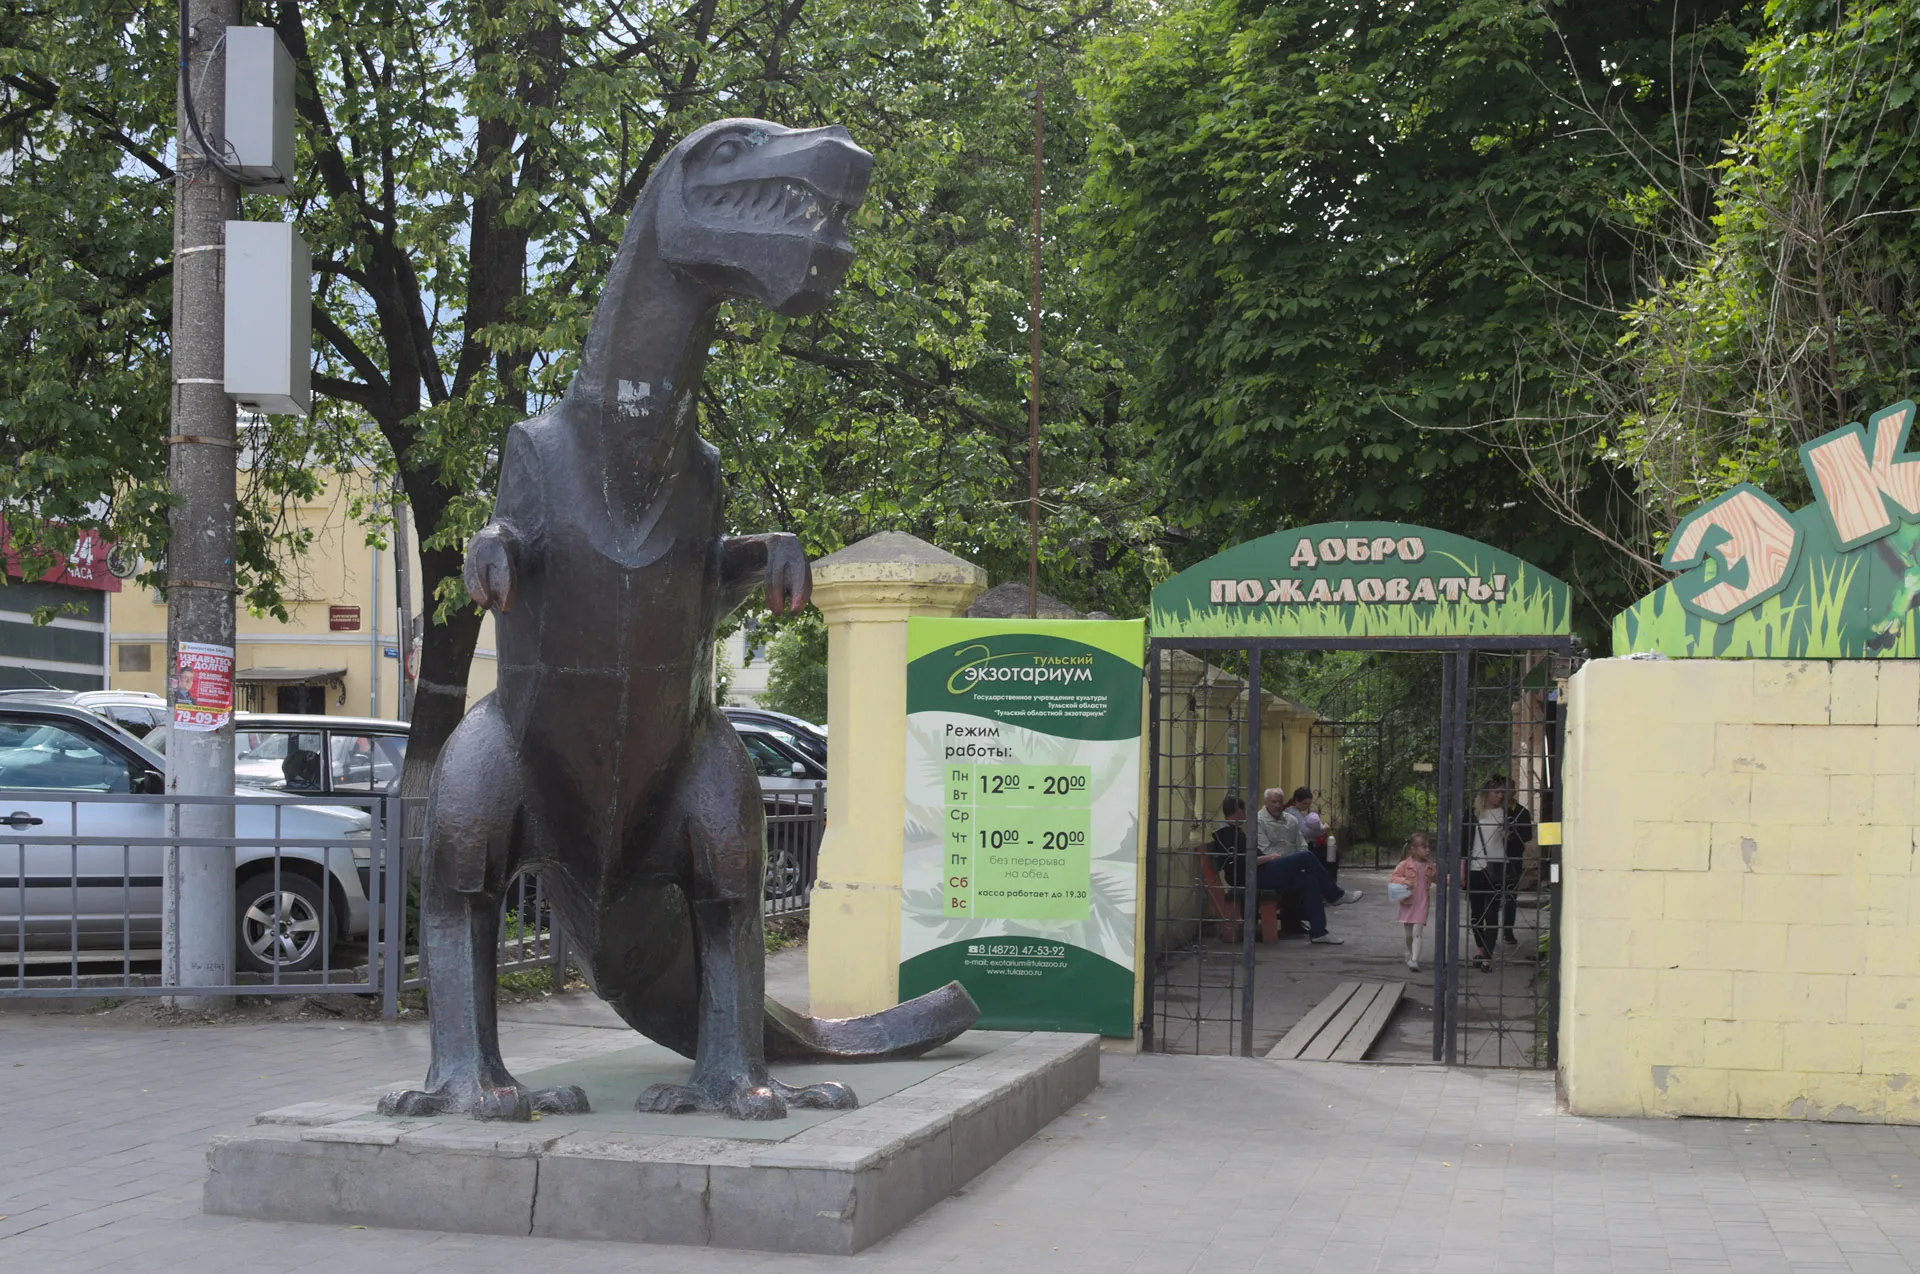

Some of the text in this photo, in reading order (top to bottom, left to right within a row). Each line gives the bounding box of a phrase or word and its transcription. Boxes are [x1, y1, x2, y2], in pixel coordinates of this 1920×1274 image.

[1290, 537, 1425, 568] ДОБРО
[1210, 574, 1507, 603] ПОЖАЛОВАТЬ!
[180, 654, 232, 667] ИЗБАВЬТЕСЬ
[1033, 653, 1093, 668] тульский
[180, 660, 229, 673] ОТ ДОЛГОВ
[965, 667, 1093, 685] экзотариум
[1033, 694, 1075, 702] учреждение
[945, 724, 1000, 737] Режим
[945, 744, 1012, 759] работы:
[952, 770, 969, 781] Пн
[953, 790, 968, 800] Вт
[950, 809, 969, 822] Ср
[952, 832, 967, 843] Чт
[951, 854, 967, 865] Пт
[989, 855, 1066, 867] без перерыва
[1005, 868, 1050, 879] на обед
[949, 876, 968, 888] Сб
[978, 889, 1087, 899] касса работает до 19.30
[952, 897, 967, 908] Вс
[988, 945, 1018, 956] (4872)
[1022, 946, 1065, 956] 47-53-92
[964, 958, 1067, 968] e-mail: exotarium@tulazoo.ru
[986, 968, 1042, 976] www.tulazoo.ru
